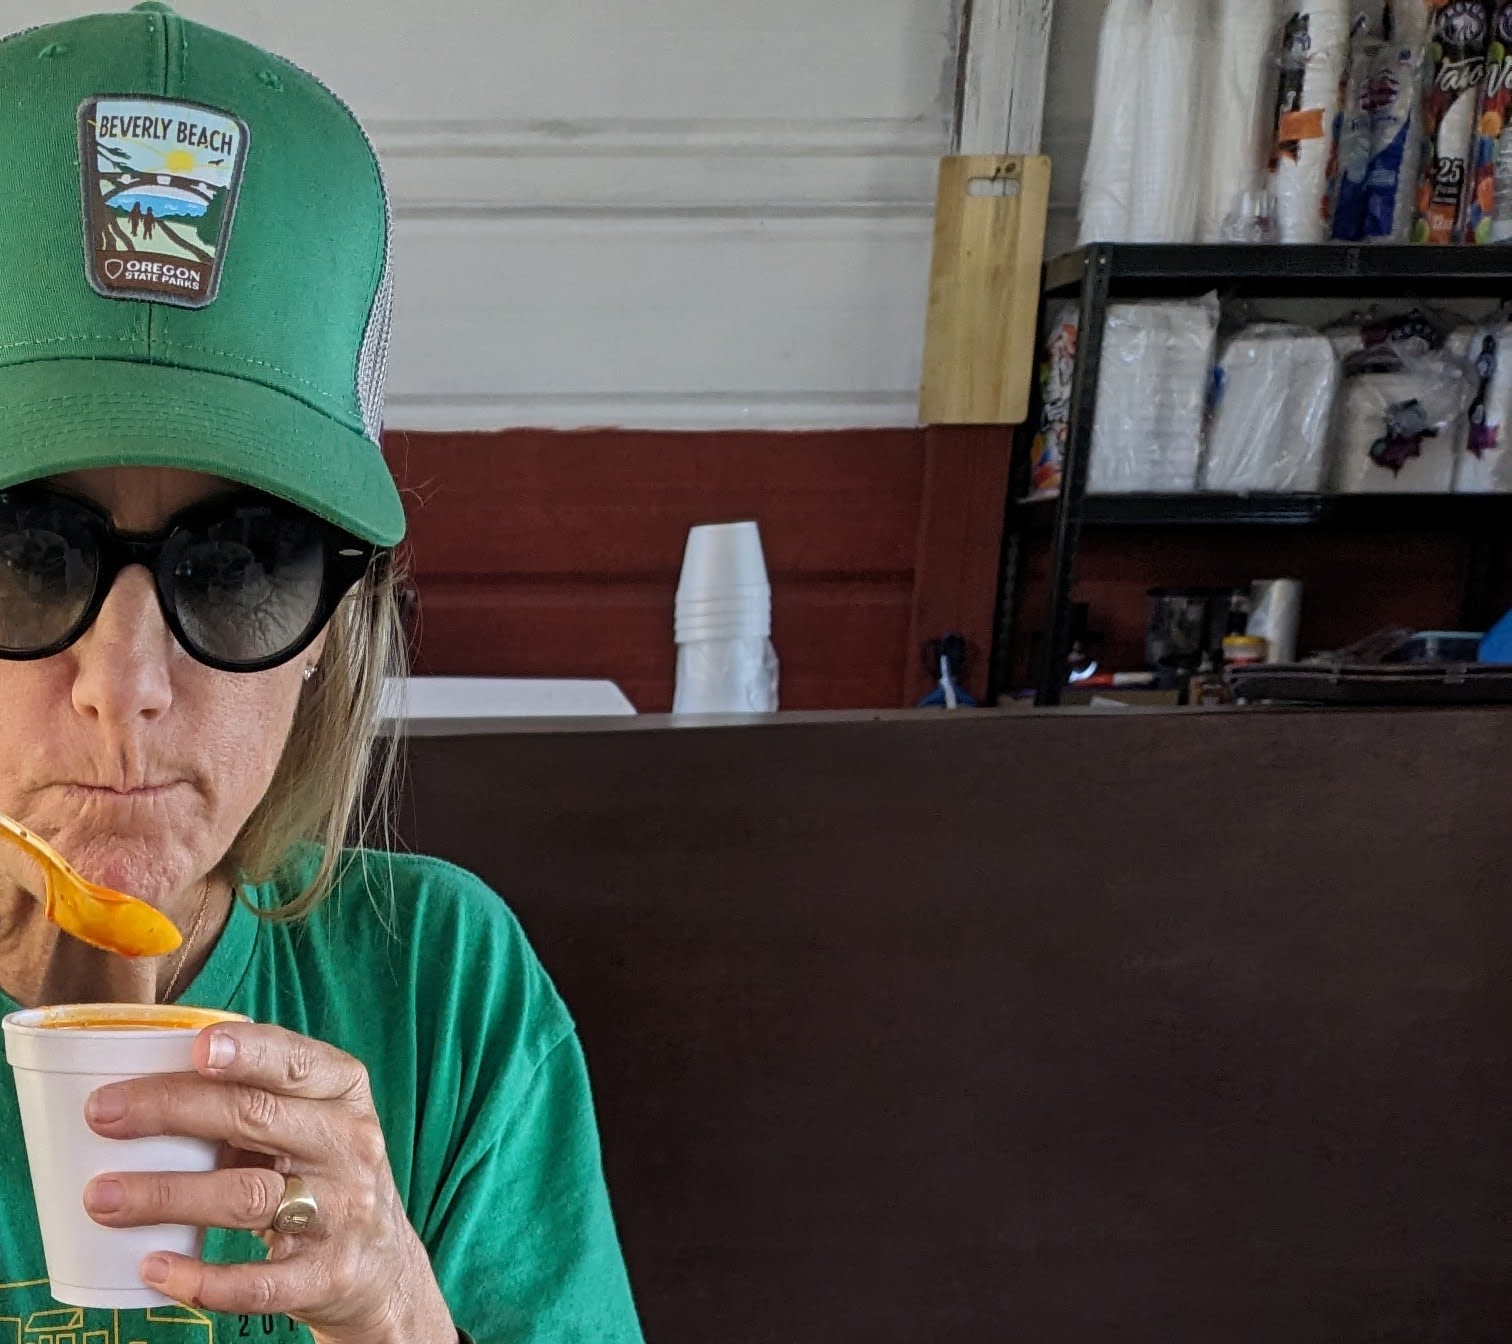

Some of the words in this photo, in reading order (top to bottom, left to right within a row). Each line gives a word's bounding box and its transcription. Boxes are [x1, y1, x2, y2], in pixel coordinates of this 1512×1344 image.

[99, 115, 173, 140] BEVERLY
[177, 120, 233, 156] BEACH
[125, 271, 159, 282] STATE
[161, 275, 200, 291] PARKS
[126, 260, 201, 282] OREGON
